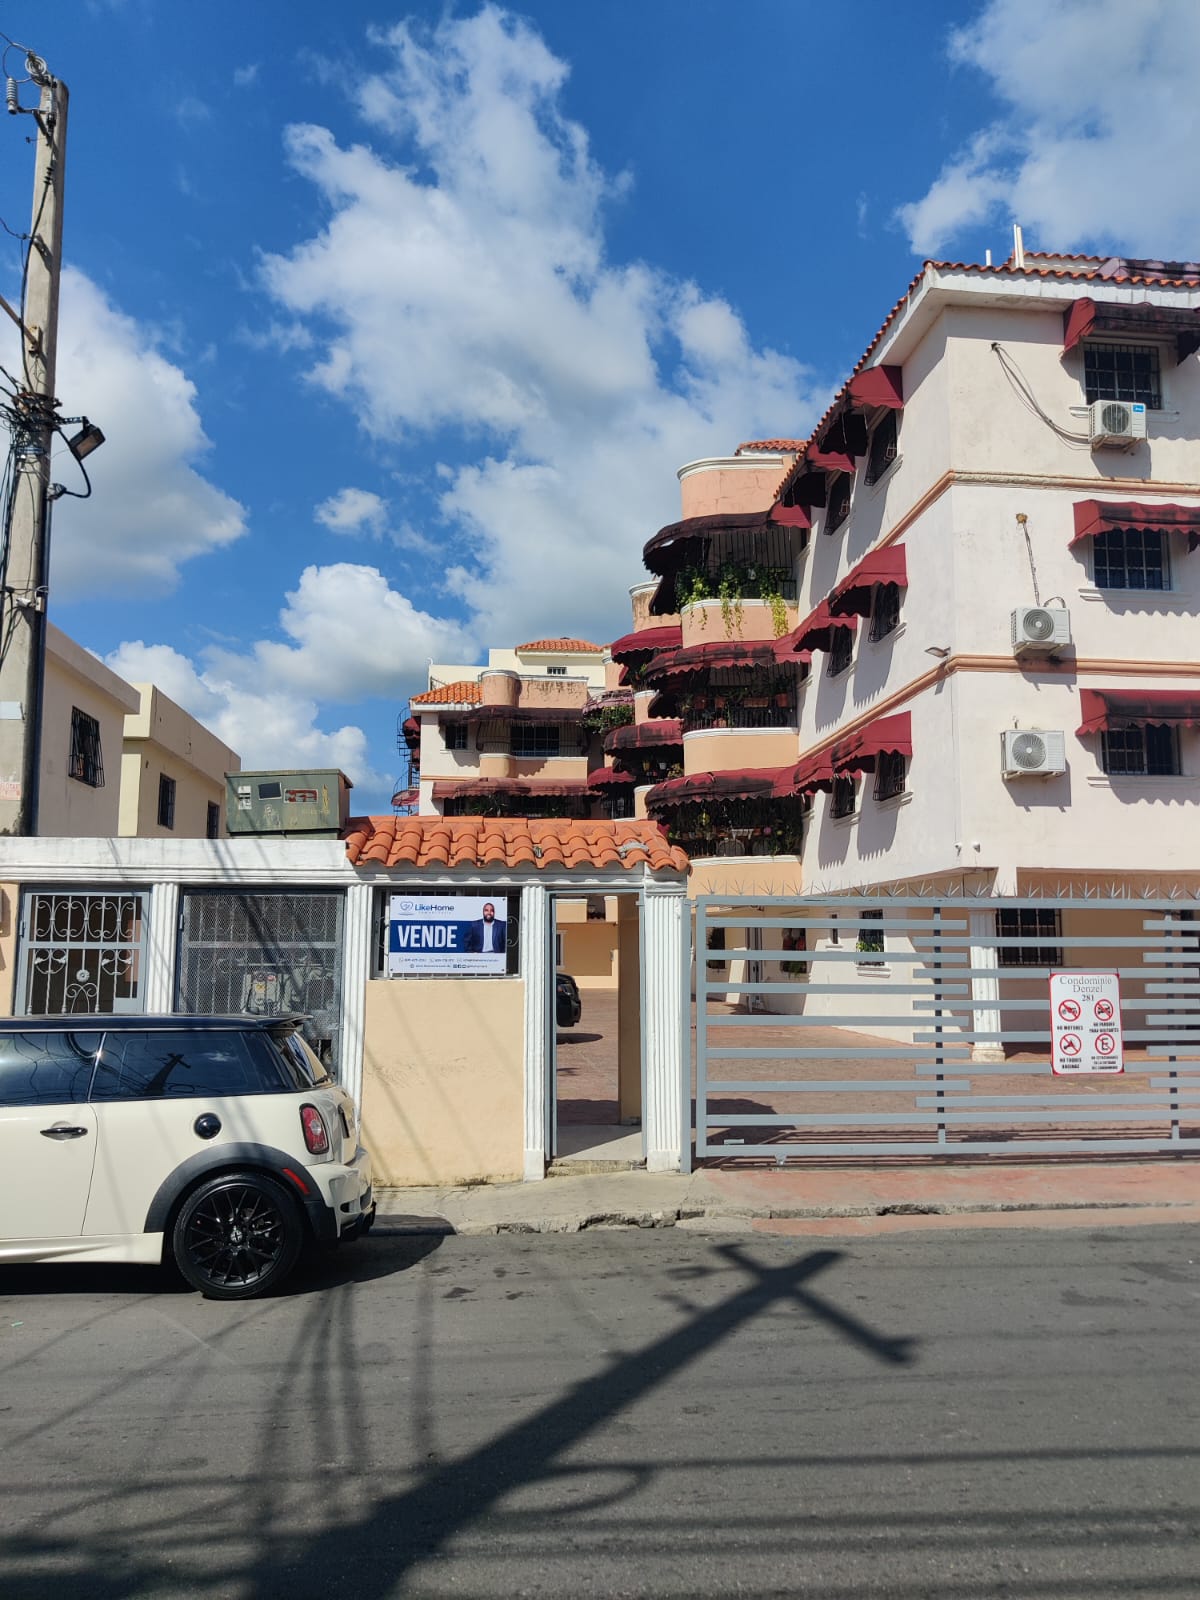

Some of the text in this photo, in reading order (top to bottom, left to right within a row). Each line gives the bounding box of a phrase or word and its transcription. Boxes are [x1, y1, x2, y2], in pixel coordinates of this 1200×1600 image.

[414, 903, 454, 911] LikeHome
[397, 925, 458, 948] VENDE
[1059, 976, 1112, 985] Condominio
[1073, 985, 1103, 993] Denzel
